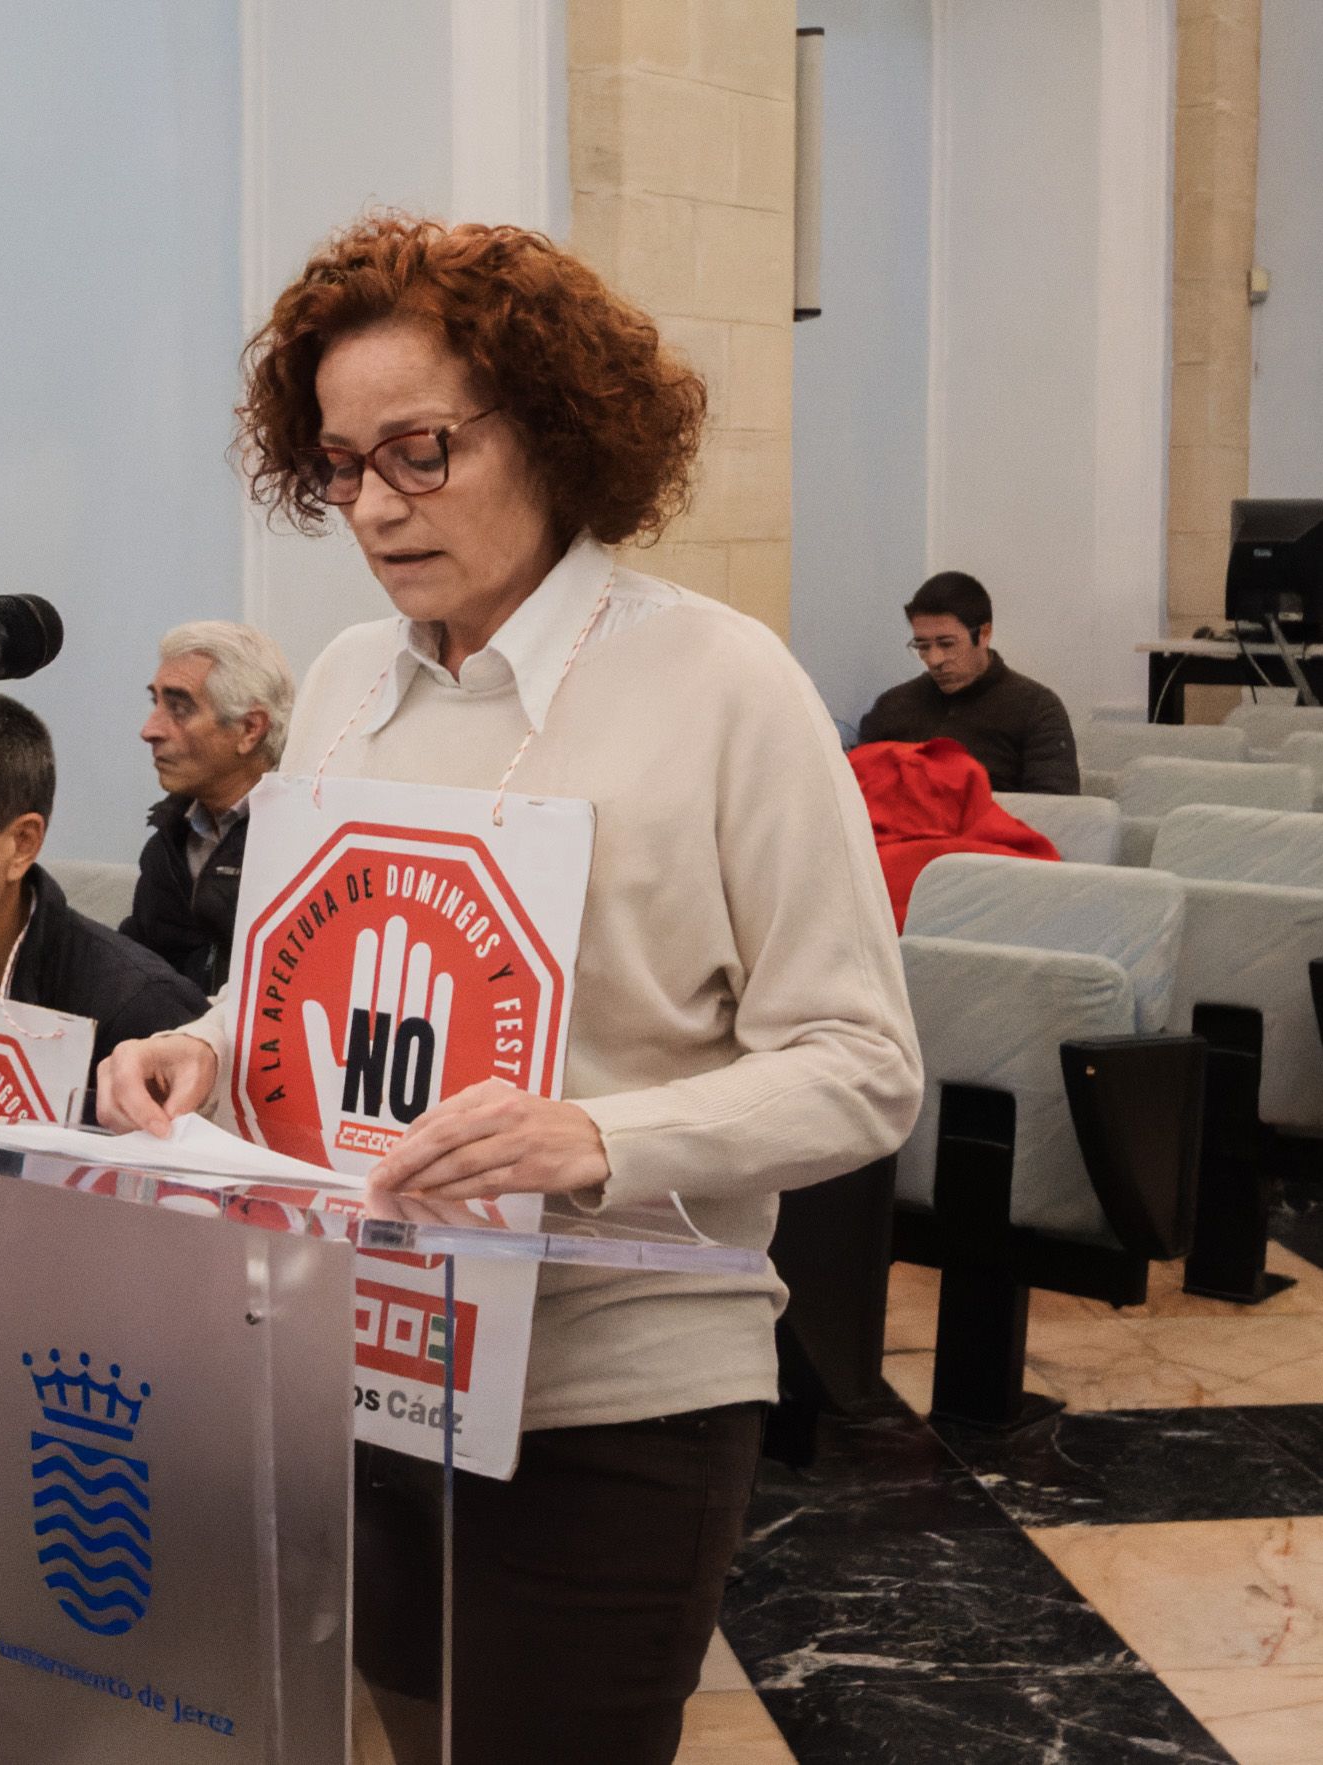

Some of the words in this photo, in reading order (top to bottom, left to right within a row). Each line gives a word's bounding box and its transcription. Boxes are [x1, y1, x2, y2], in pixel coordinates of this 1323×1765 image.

[346, 867, 374, 904] DE
[386, 864, 500, 959] DOMINGOS
[262, 889, 340, 1022] APERTURA
[488, 962, 515, 983] Y
[261, 1037, 282, 1073] LA
[341, 1008, 436, 1125] NO
[491, 997, 524, 1088] FEST
[264, 1085, 286, 1103] A
[387, 1389, 464, 1435] Cádz
[137, 1680, 166, 1712] de
[172, 1695, 236, 1737] Jerez
